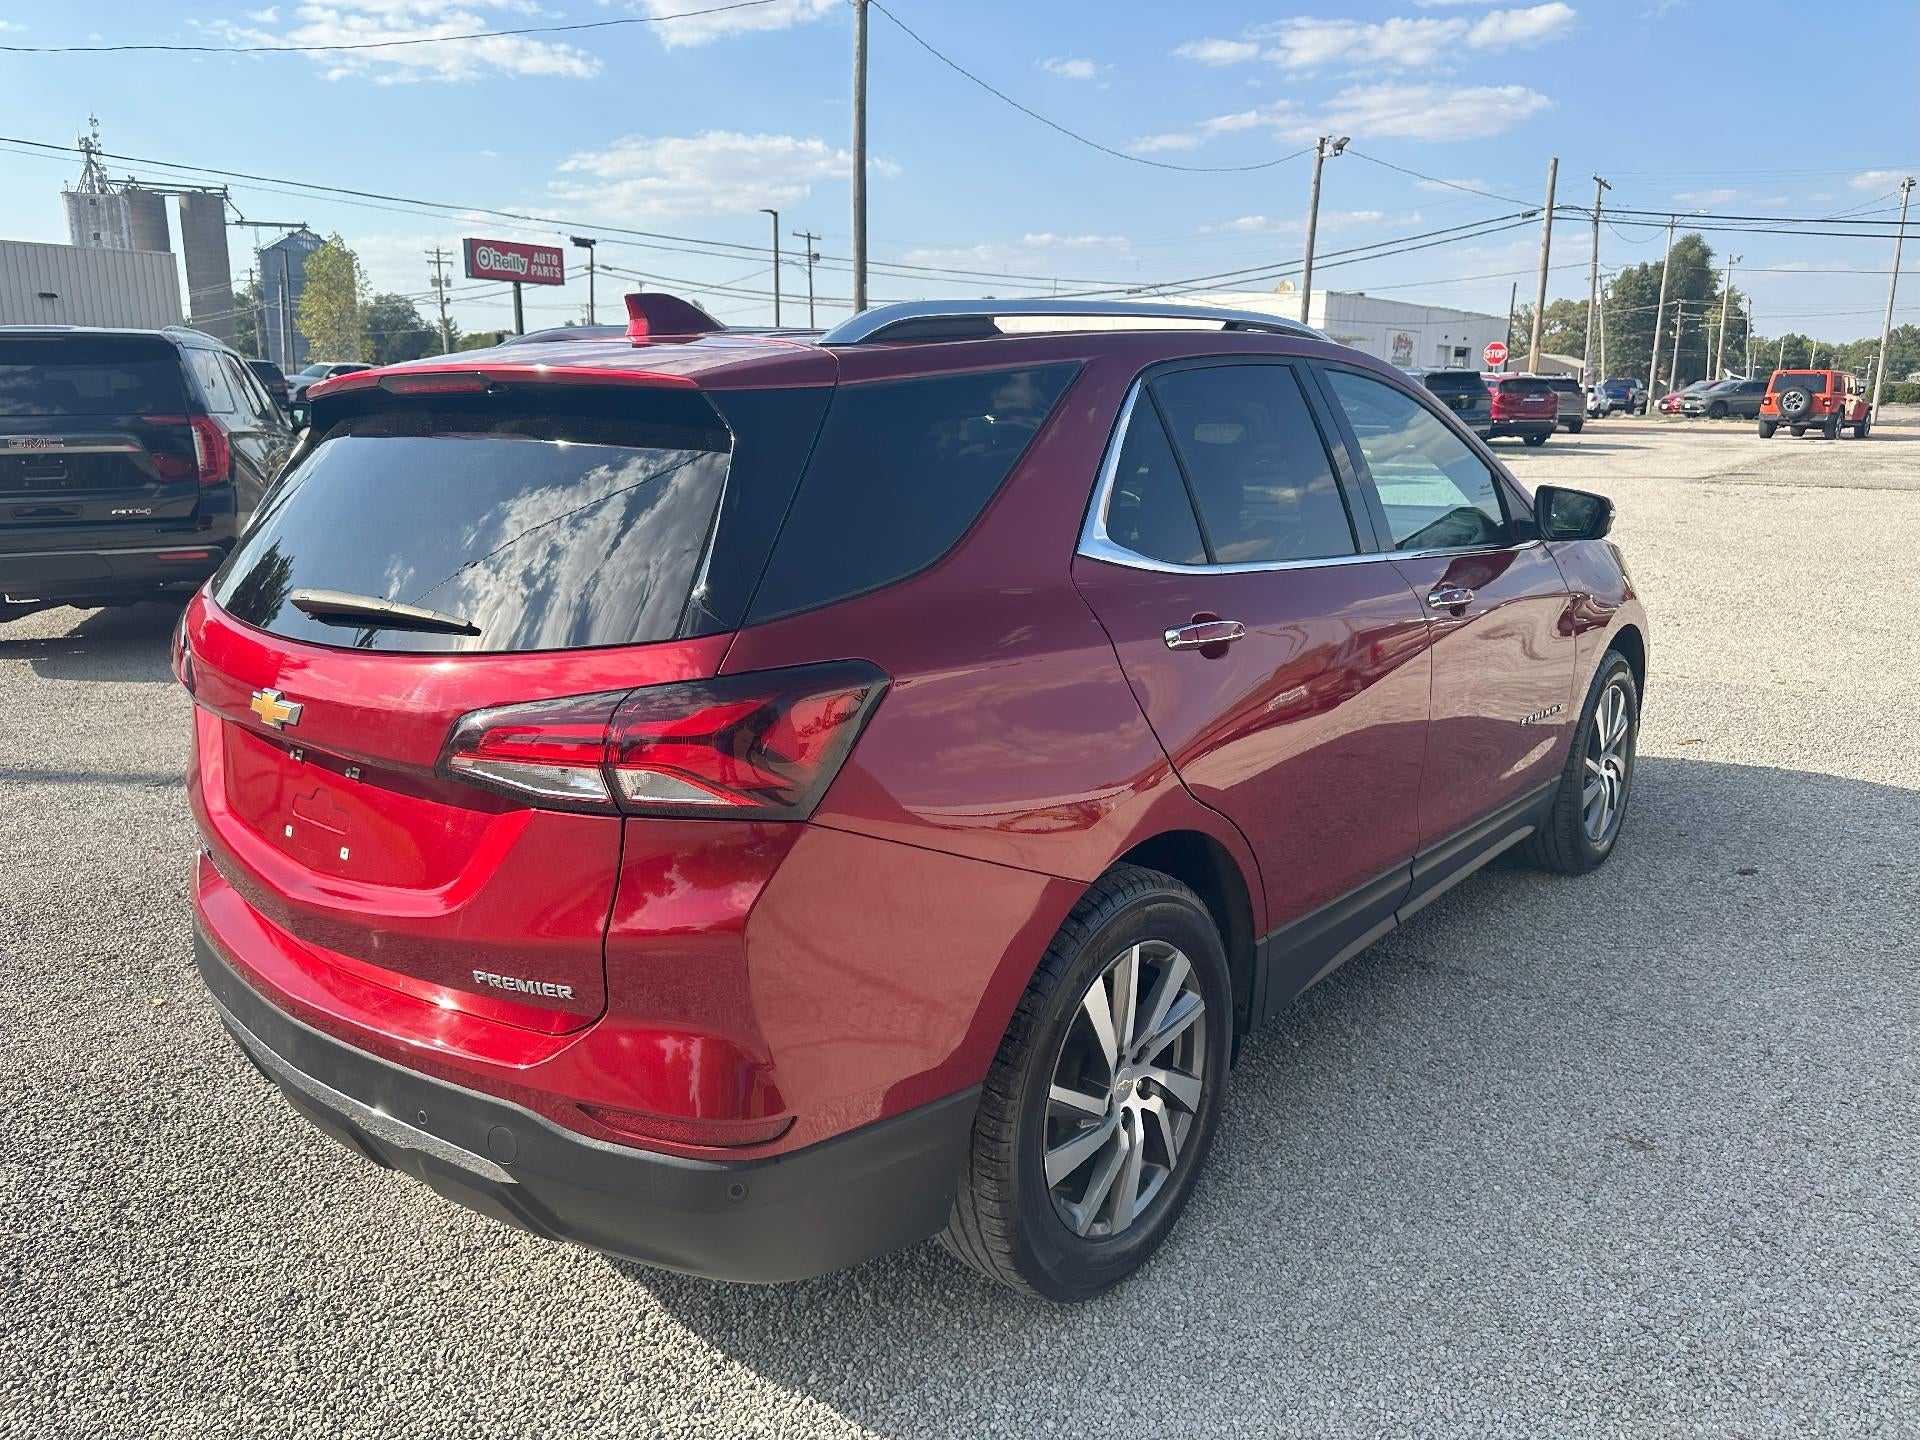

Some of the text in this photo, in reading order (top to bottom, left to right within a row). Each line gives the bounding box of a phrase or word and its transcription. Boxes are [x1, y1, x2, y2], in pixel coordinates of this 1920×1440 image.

[476, 246, 528, 275] O'Reilly
[533, 252, 558, 266] AUTO
[530, 264, 561, 278] PARTS
[1485, 348, 1506, 358] STOP
[8, 438, 64, 449] GMC
[472, 969, 575, 1000] PREMIER
